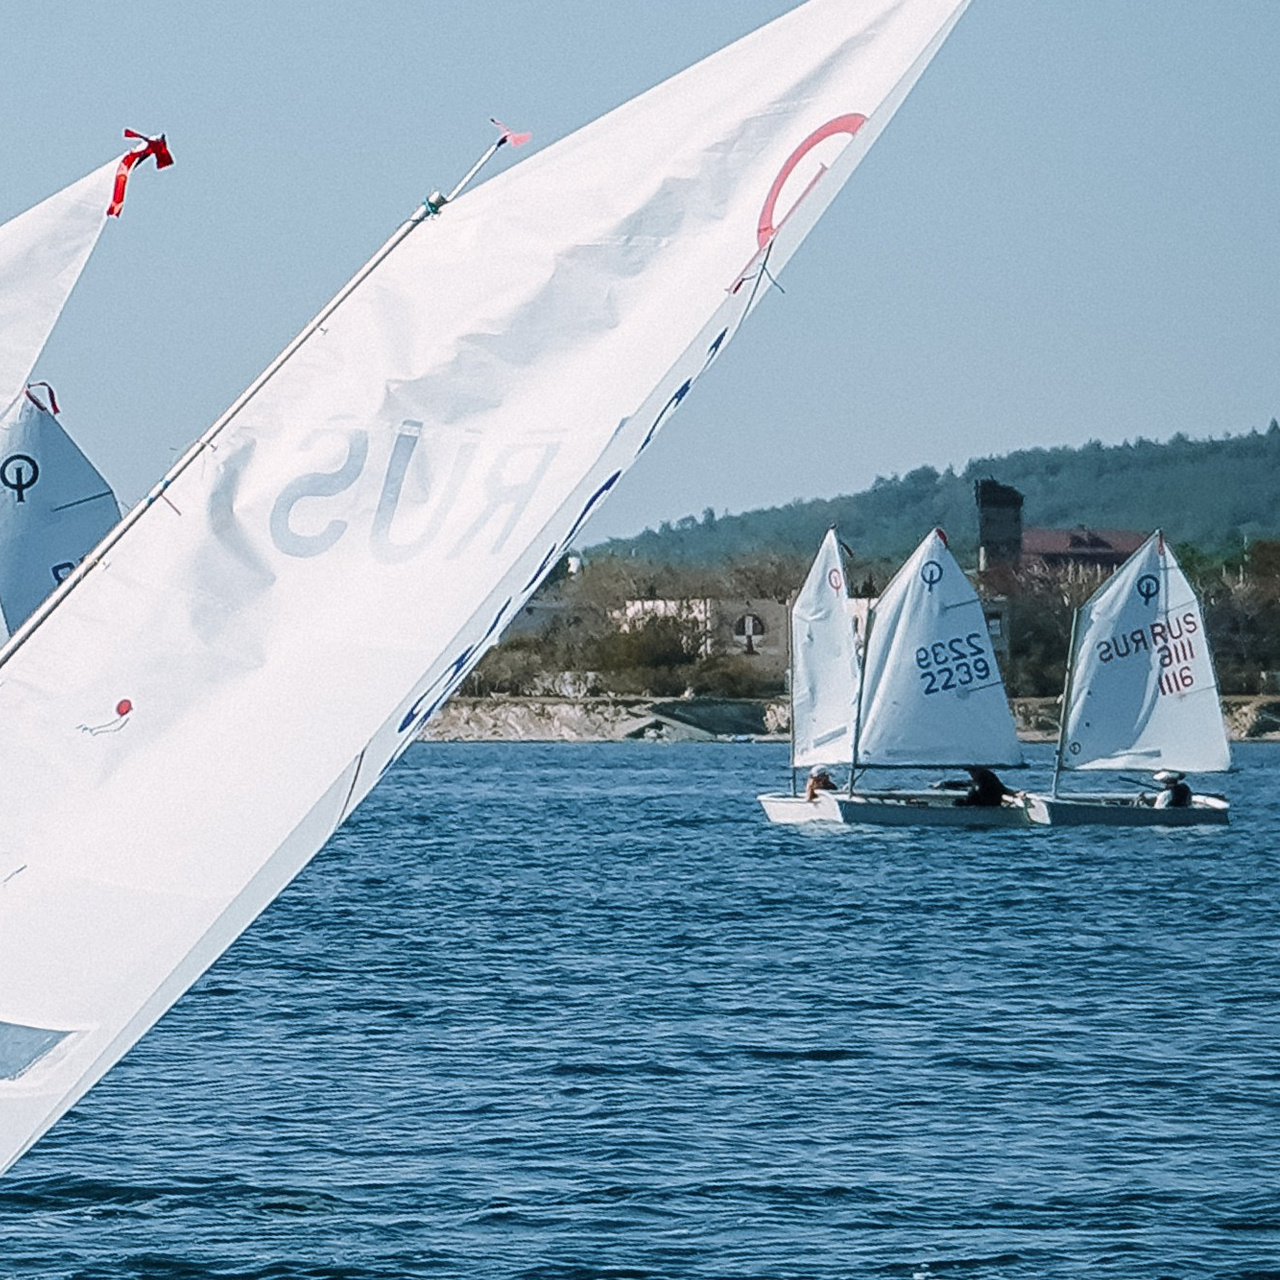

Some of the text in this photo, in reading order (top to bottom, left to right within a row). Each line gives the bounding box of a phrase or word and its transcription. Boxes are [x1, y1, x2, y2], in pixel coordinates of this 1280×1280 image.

[1149, 612, 1198, 646] RUS
[920, 658, 990, 695] 2239
[1158, 665, 1194, 696] 1116
